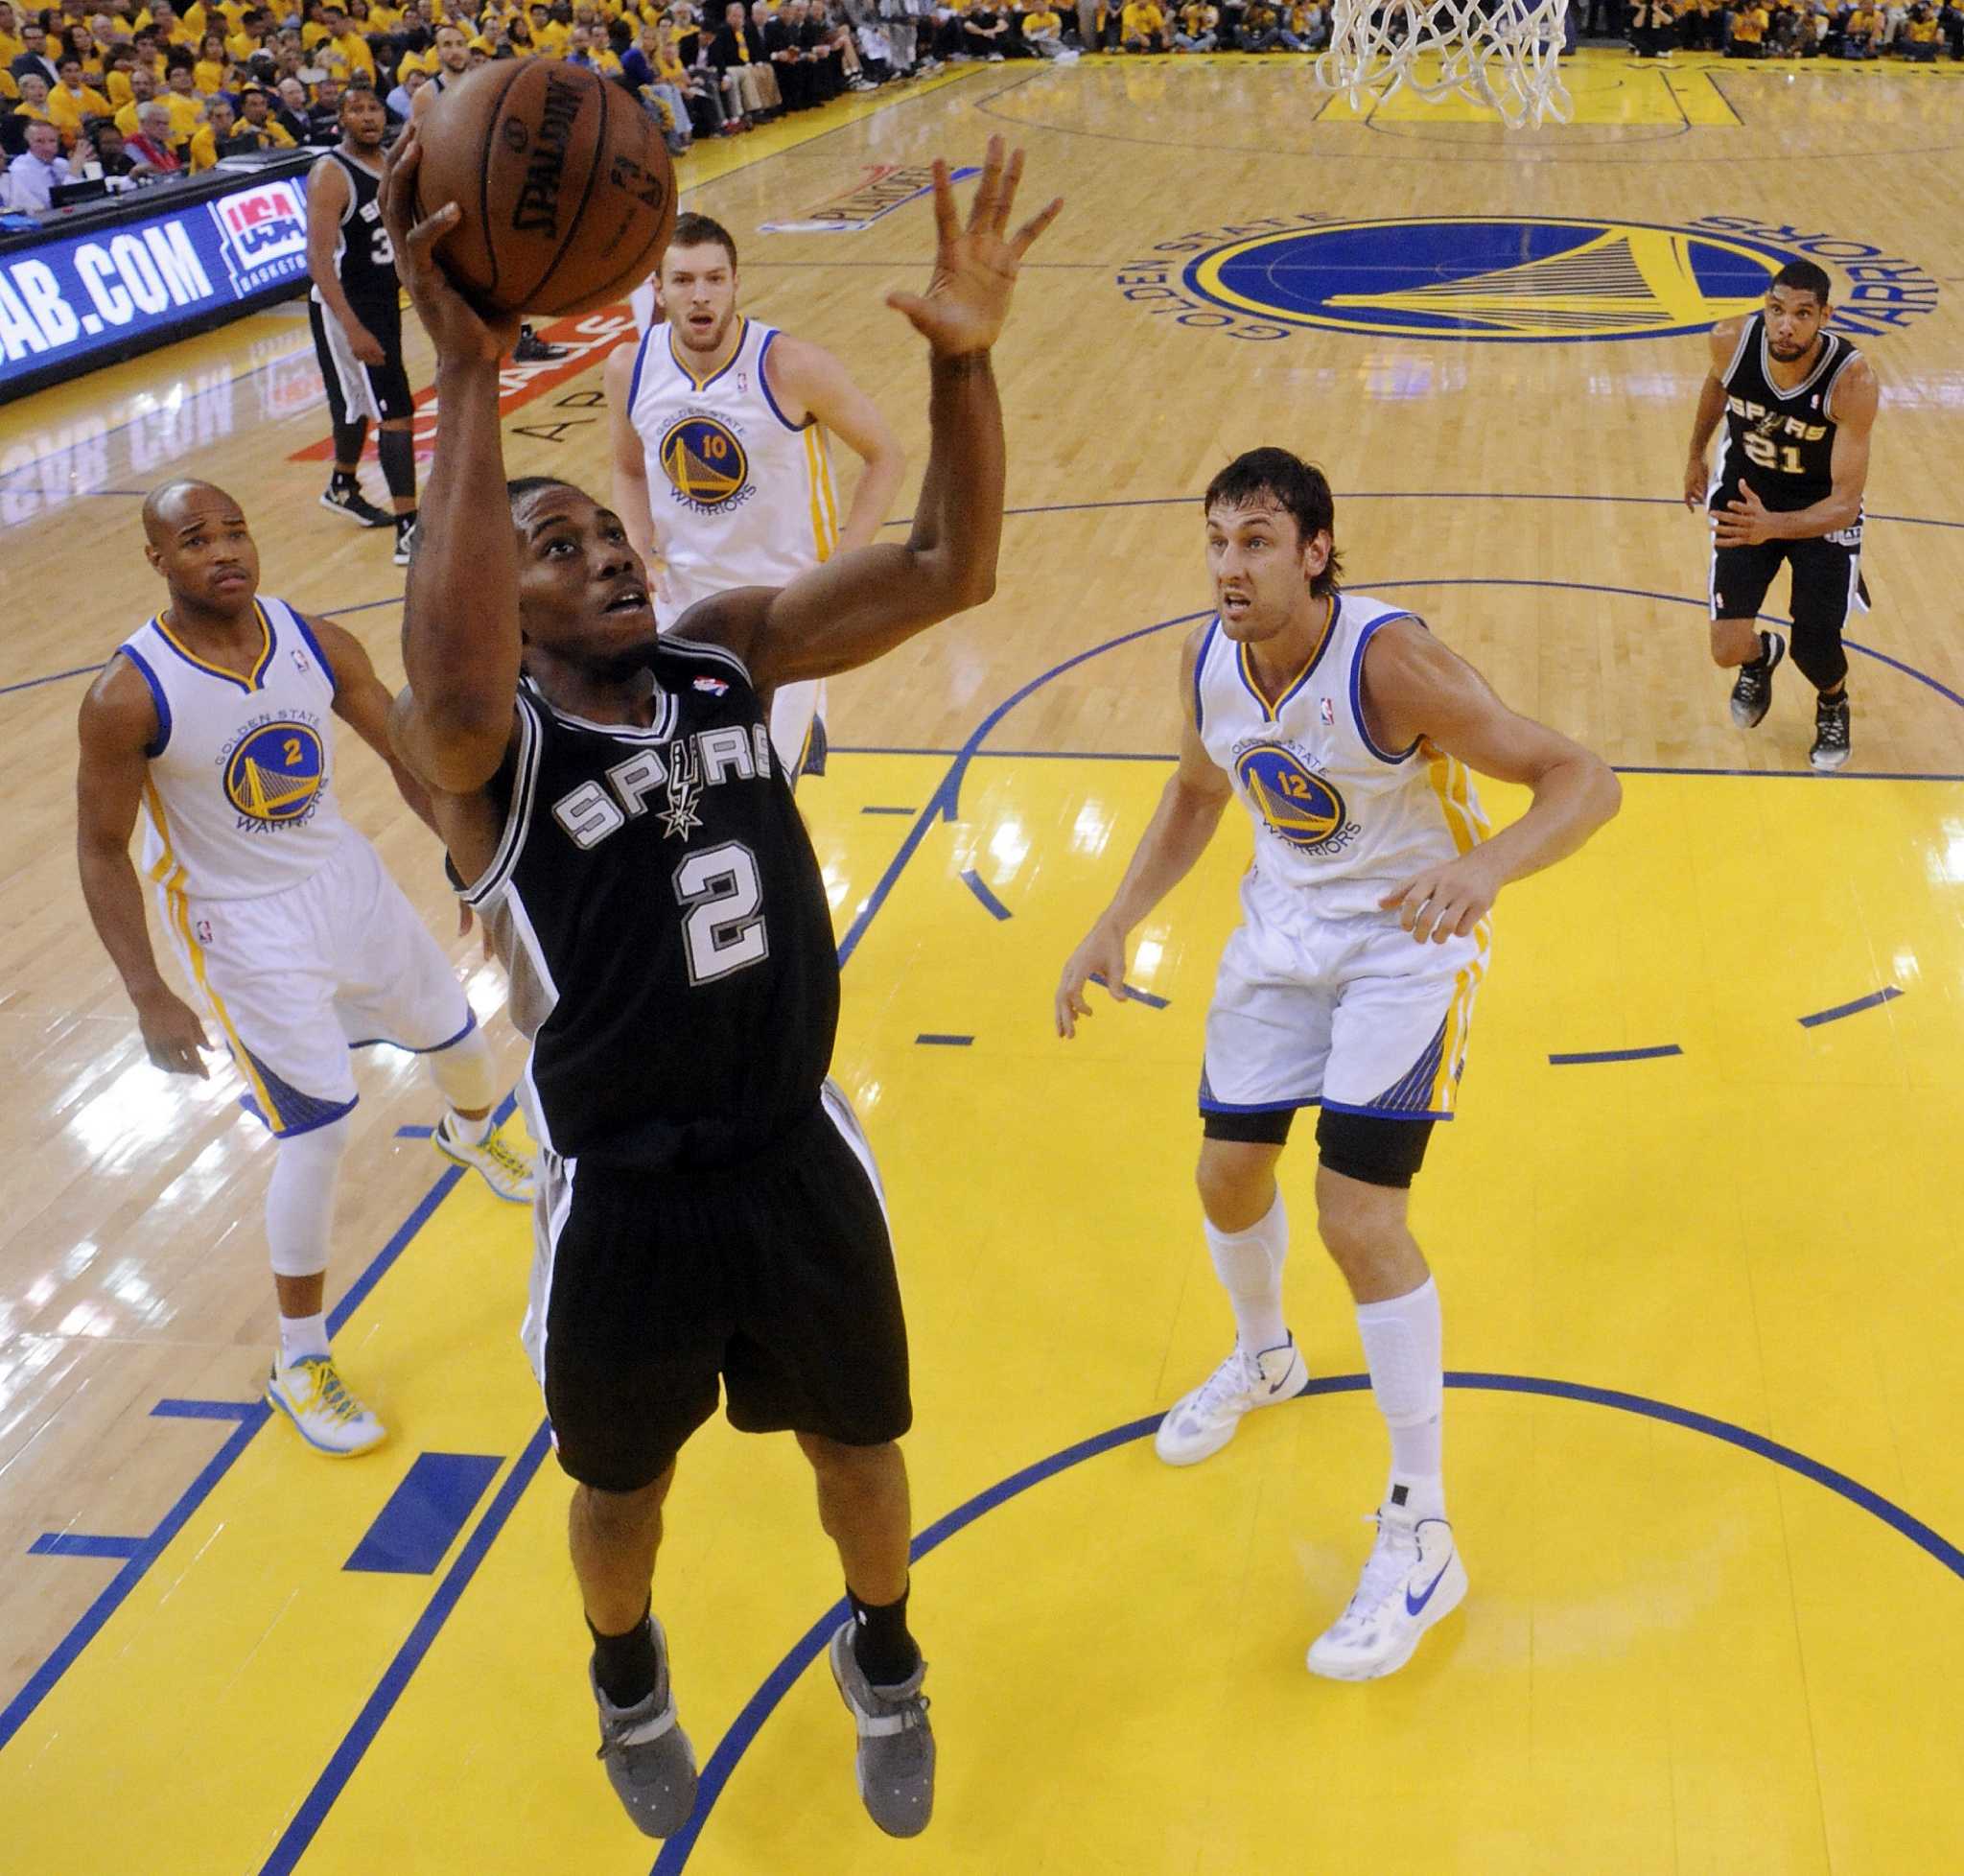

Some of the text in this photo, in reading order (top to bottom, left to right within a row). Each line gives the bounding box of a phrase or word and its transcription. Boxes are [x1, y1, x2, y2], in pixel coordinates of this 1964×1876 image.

[371, 227, 394, 264] 3
[241, 254, 307, 292] BASKETB
[1116, 211, 1346, 340] GOLDEN STATE
[0, 221, 214, 364] AB.COM
[656, 407, 746, 435] GOLDEN STATE
[1728, 395, 1827, 440] SPURS
[702, 434, 728, 459] 10
[1742, 432, 1806, 474] 21
[670, 483, 757, 516] WARRIORS
[215, 709, 319, 765] GOLDEN STATE
[283, 738, 303, 766] 2
[1288, 739, 1330, 777] STATE
[1277, 771, 1312, 800] 12
[1263, 818, 1362, 856] RIORS
[672, 839, 769, 987] 2
